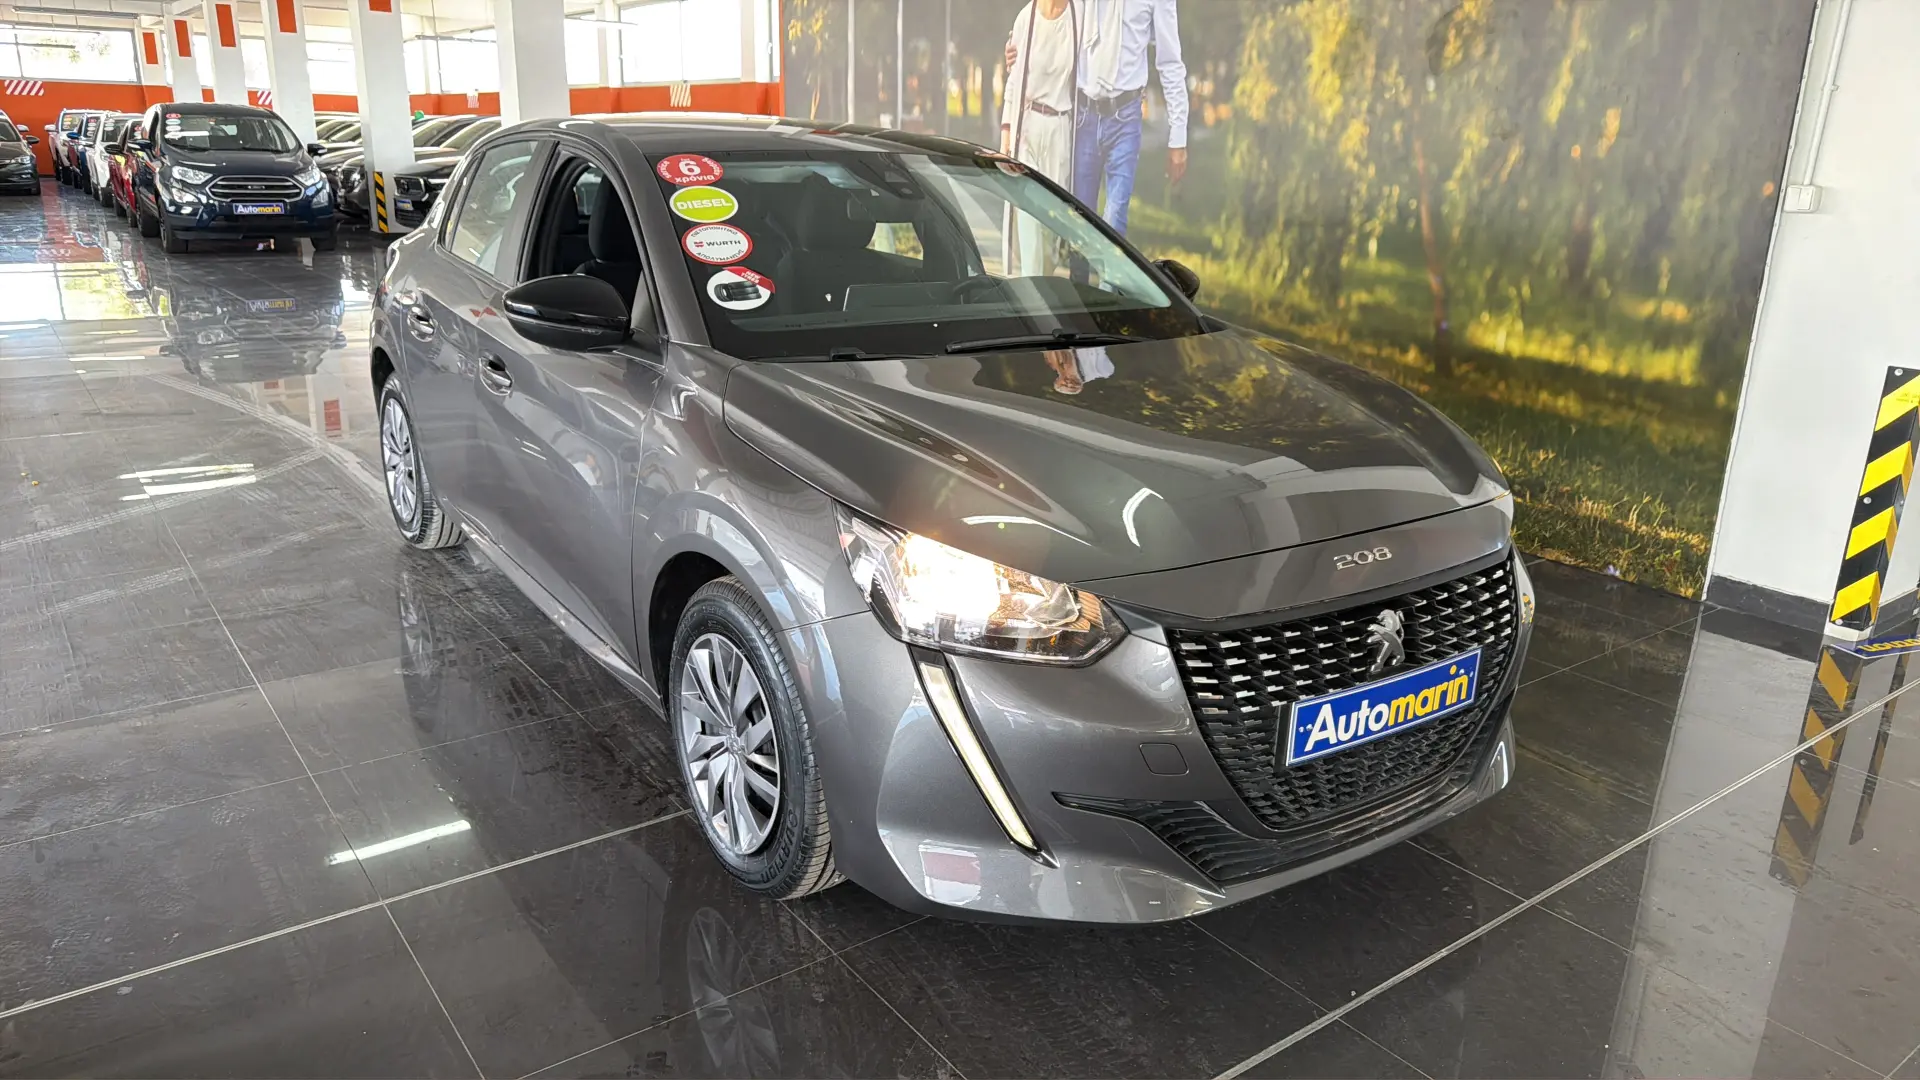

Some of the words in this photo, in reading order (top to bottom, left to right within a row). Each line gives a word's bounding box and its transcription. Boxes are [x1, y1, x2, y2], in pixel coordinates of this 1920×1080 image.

[678, 160, 701, 176] 6
[675, 174, 715, 183] χρόνια
[237, 204, 281, 213] Automarin
[676, 198, 733, 210] DIESEL
[745, 270, 761, 280] NEW
[1333, 546, 1393, 570] 208
[1304, 664, 1470, 752] Automarin
